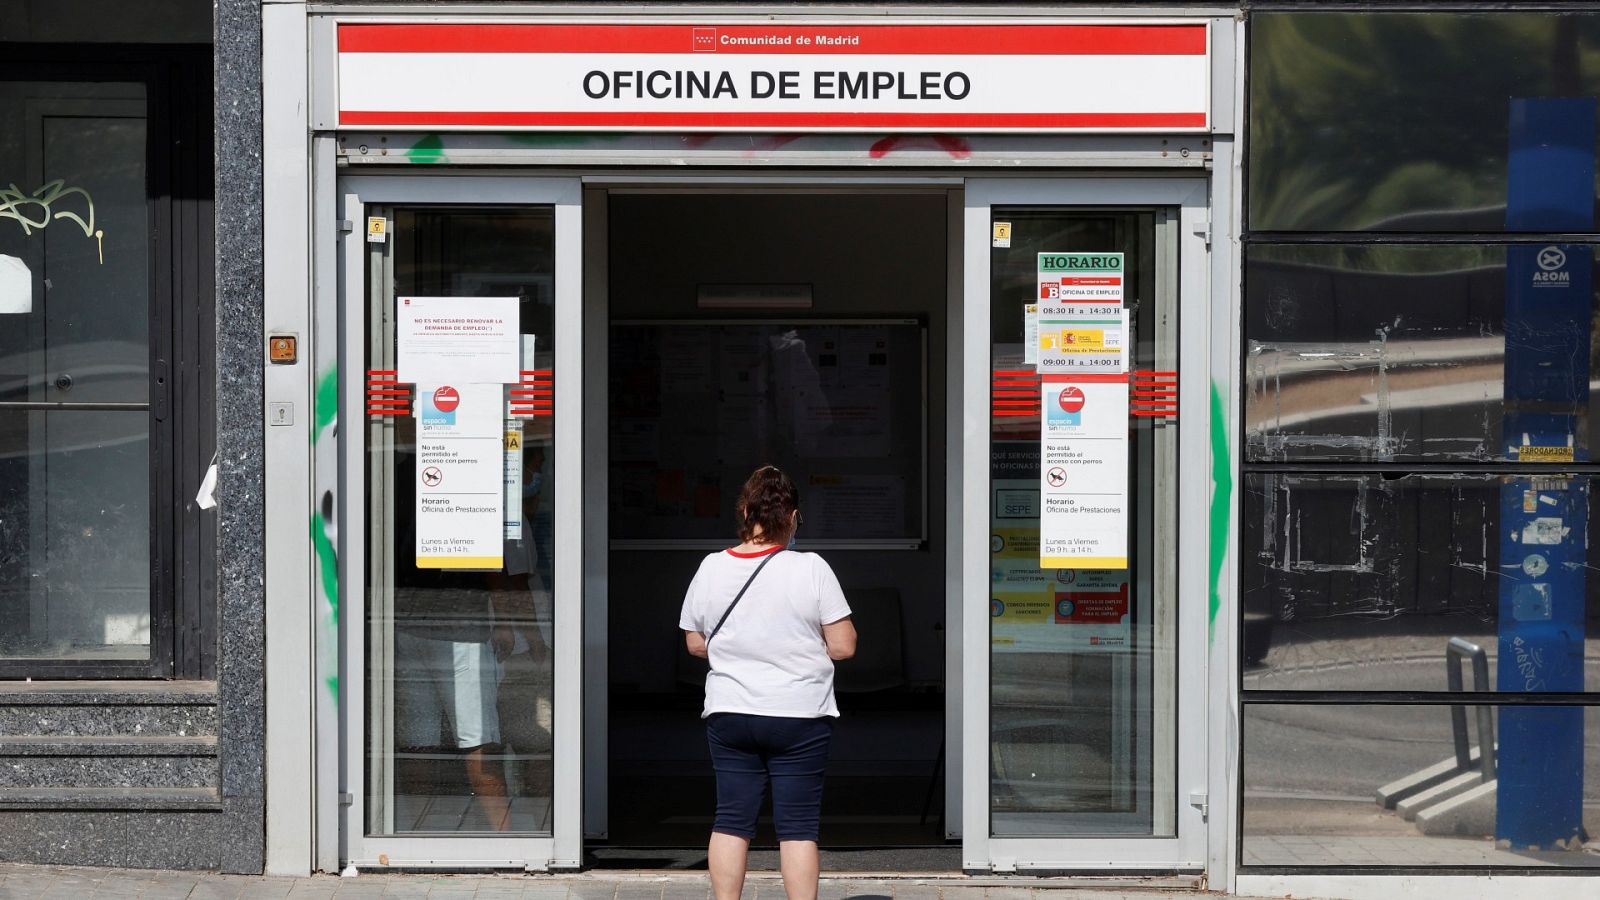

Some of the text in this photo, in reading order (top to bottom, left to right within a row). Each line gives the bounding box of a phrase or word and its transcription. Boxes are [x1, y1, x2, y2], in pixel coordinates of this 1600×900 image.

[720, 35, 859, 45] Comunidad de Madrid
[582, 70, 971, 100] OFICINA DE EMPLEO
[1044, 256, 1120, 268] HORARIO
[1048, 288, 1059, 298] B
[1005, 505, 1032, 514] SEPE
